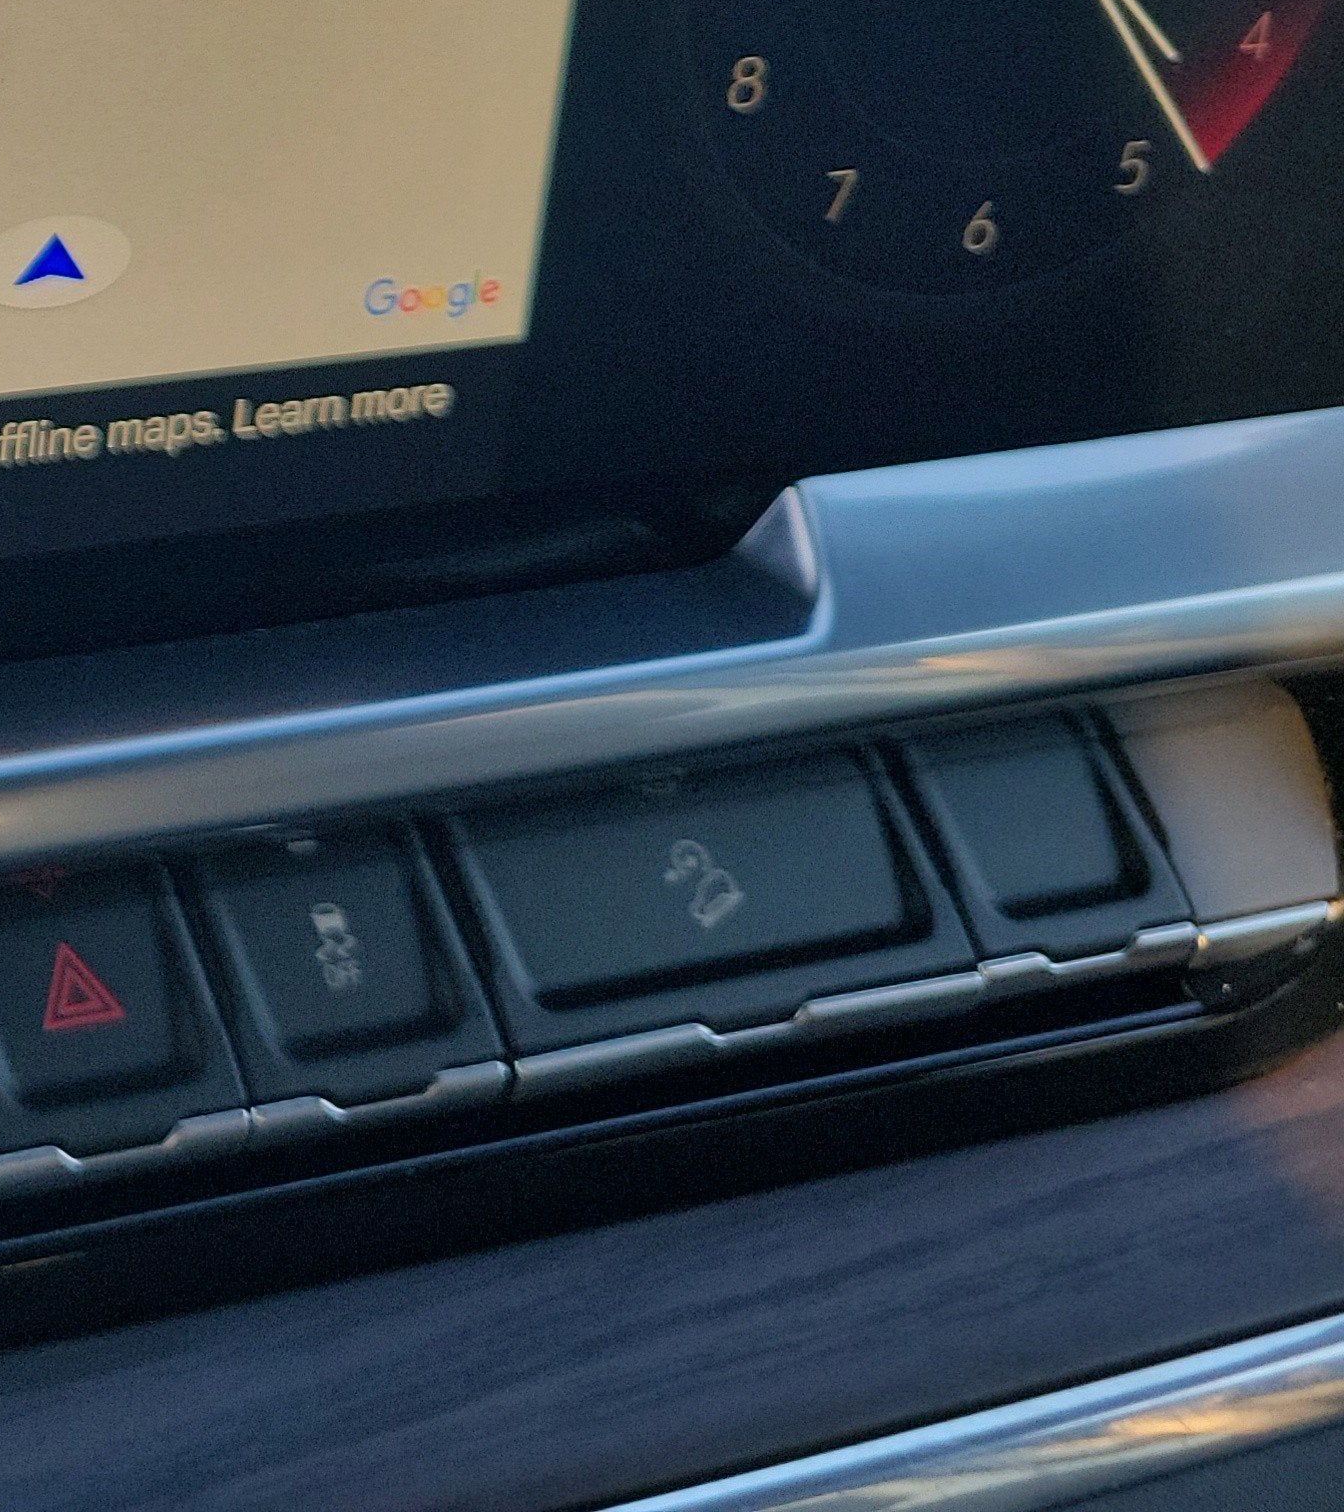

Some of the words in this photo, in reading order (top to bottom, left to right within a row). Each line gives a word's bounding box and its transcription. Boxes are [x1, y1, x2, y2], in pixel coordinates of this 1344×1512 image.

[1240, 11, 1274, 61] 4
[727, 55, 766, 114] 8
[1115, 139, 1151, 195] 5
[825, 168, 858, 223] 7
[962, 200, 998, 255] 6
[364, 268, 502, 318] Google
[107, 409, 228, 456] maps.
[232, 396, 348, 439] Learn
[350, 382, 457, 420] more
